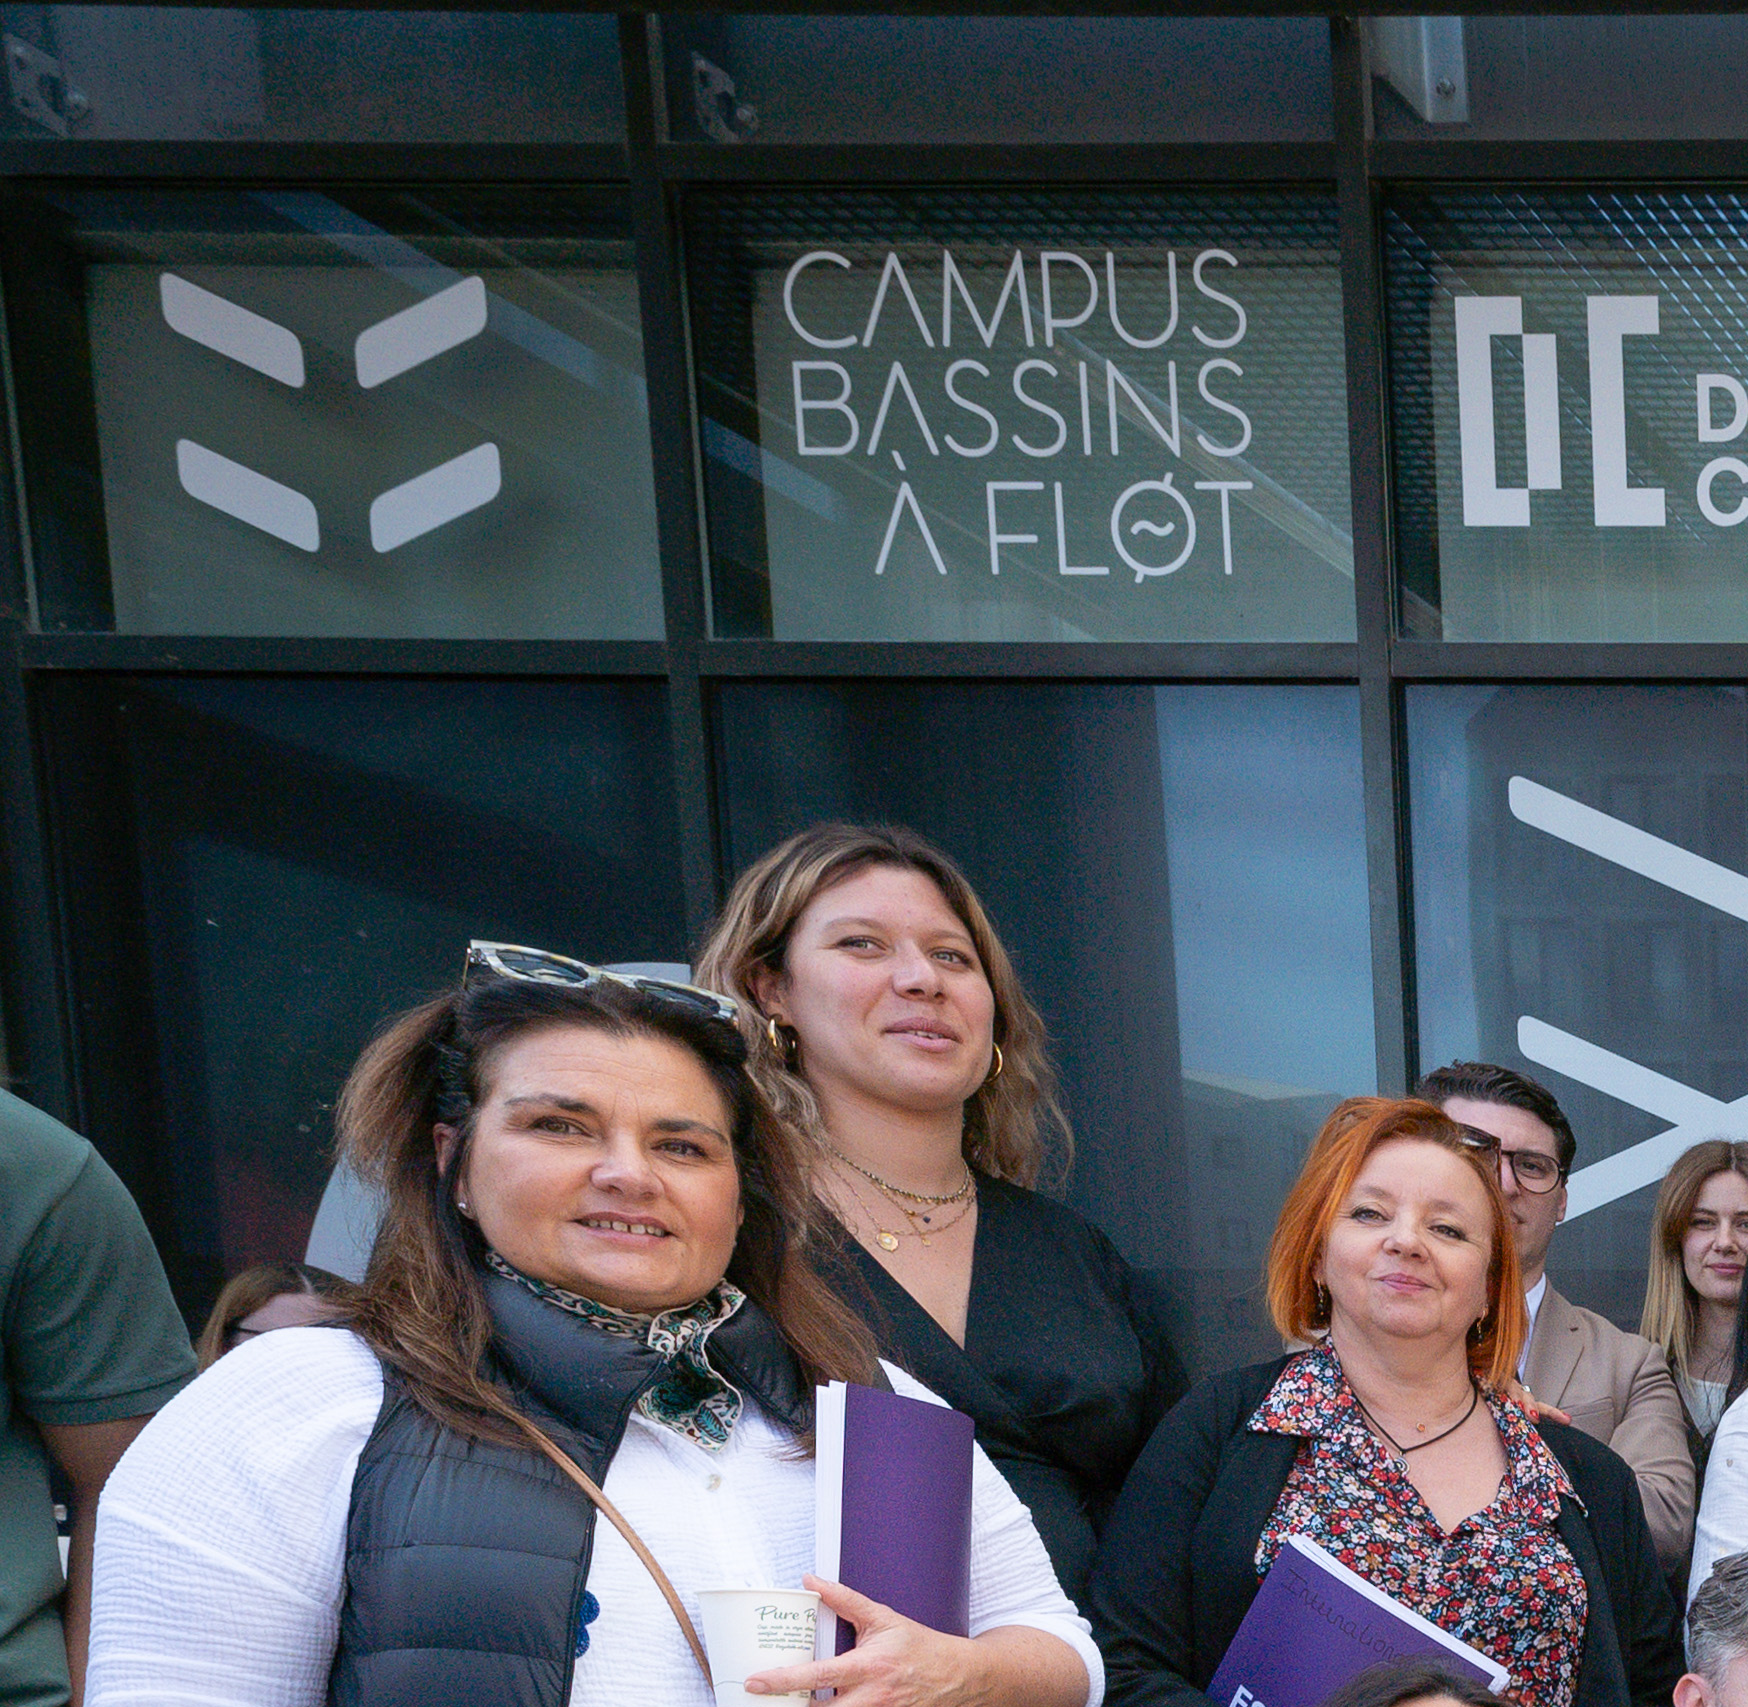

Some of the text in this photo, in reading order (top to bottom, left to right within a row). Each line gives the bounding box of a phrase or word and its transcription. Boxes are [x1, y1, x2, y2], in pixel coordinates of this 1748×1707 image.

[785, 250, 1248, 349] CAMPUS
[793, 359, 1252, 458] BASSINS
[875, 451, 947, 576] À
[755, 1605, 800, 1621] Pure
[1281, 1568, 1396, 1661] Internation
